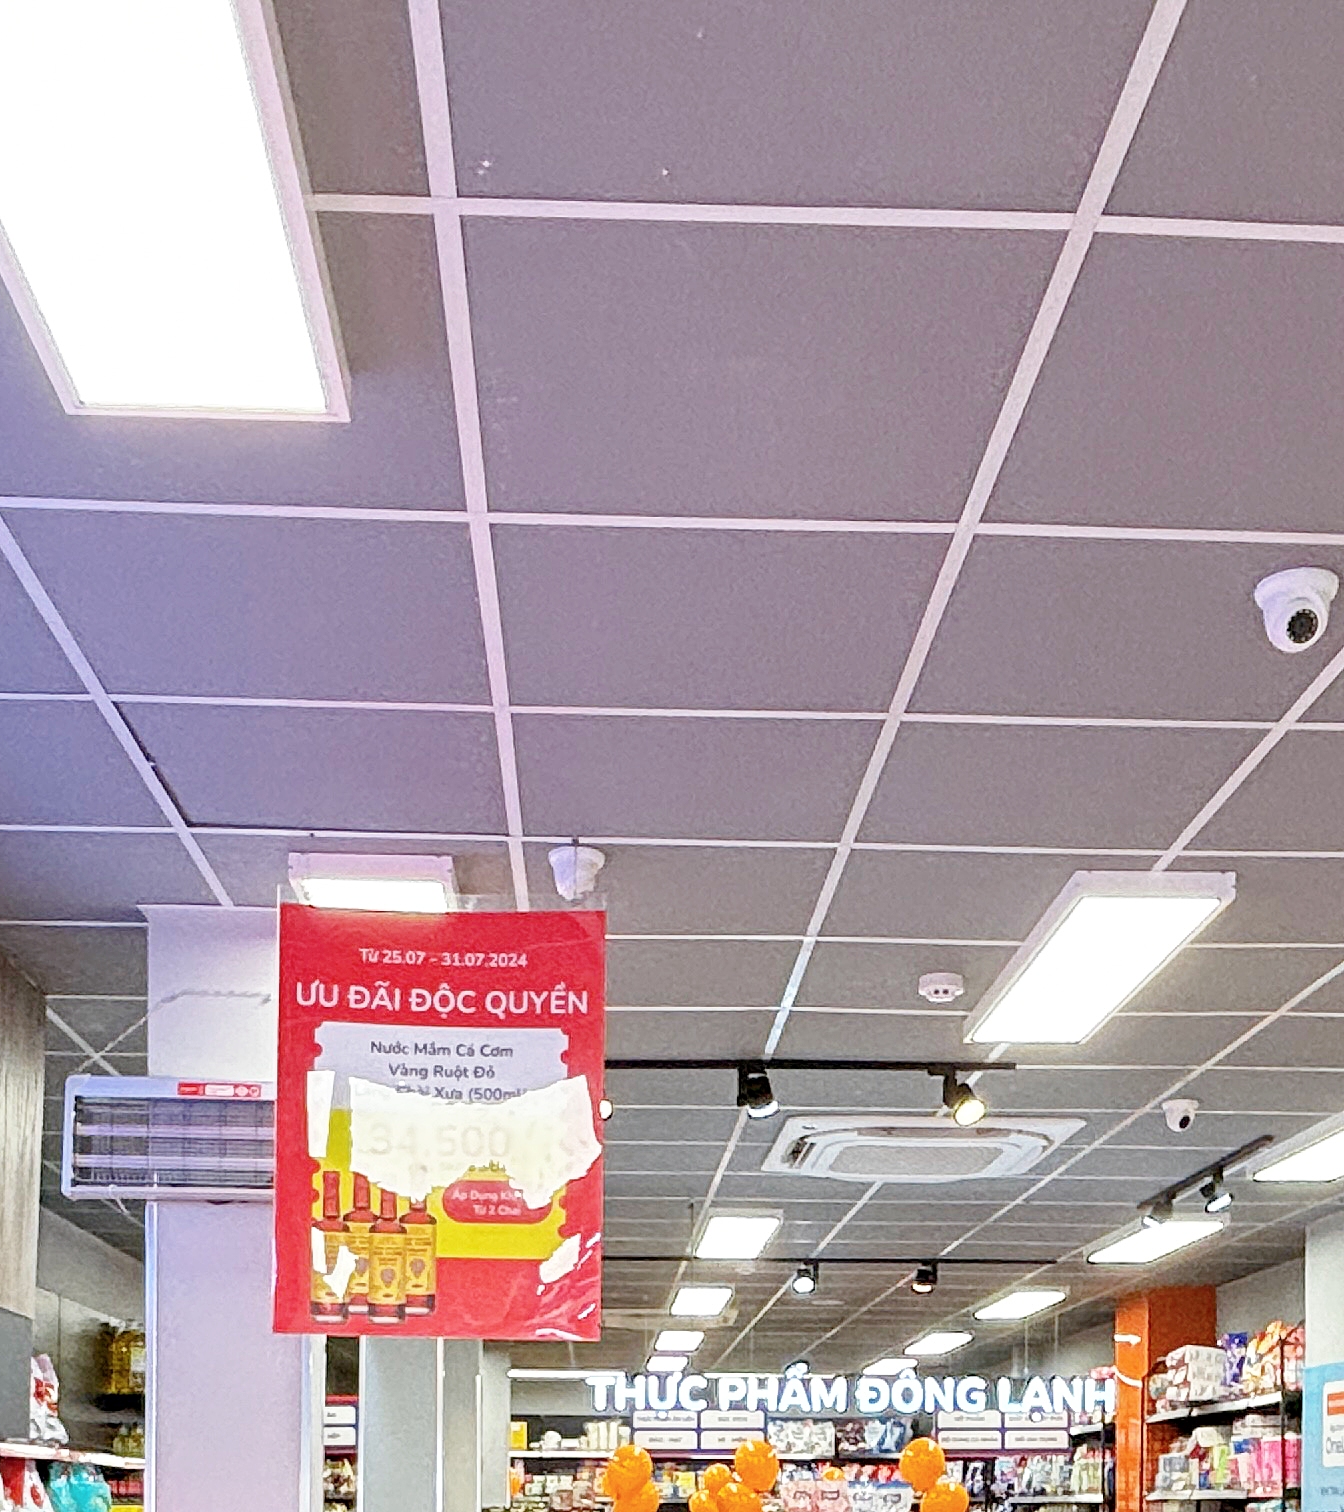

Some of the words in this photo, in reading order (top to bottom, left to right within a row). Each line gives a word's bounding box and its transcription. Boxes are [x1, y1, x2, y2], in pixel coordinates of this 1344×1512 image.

[359, 948, 379, 963] Từ
[382, 949, 426, 965] 25.07
[441, 951, 529, 968] 31.07.2024
[296, 979, 339, 1007] ƯU
[347, 981, 401, 1011] ĐÃI
[409, 983, 477, 1019] ĐỘC
[485, 981, 589, 1020] QUYỀN
[370, 1040, 409, 1057] Nước
[456, 1042, 475, 1058] Cá
[480, 1044, 514, 1058] Cơm
[433, 1065, 469, 1082] Ruột
[585, 1371, 709, 1419] THỰC
[717, 1361, 848, 1413] PHẨM
[854, 1367, 990, 1415] ĐÔNG
[997, 1374, 1117, 1423] LẠNH
